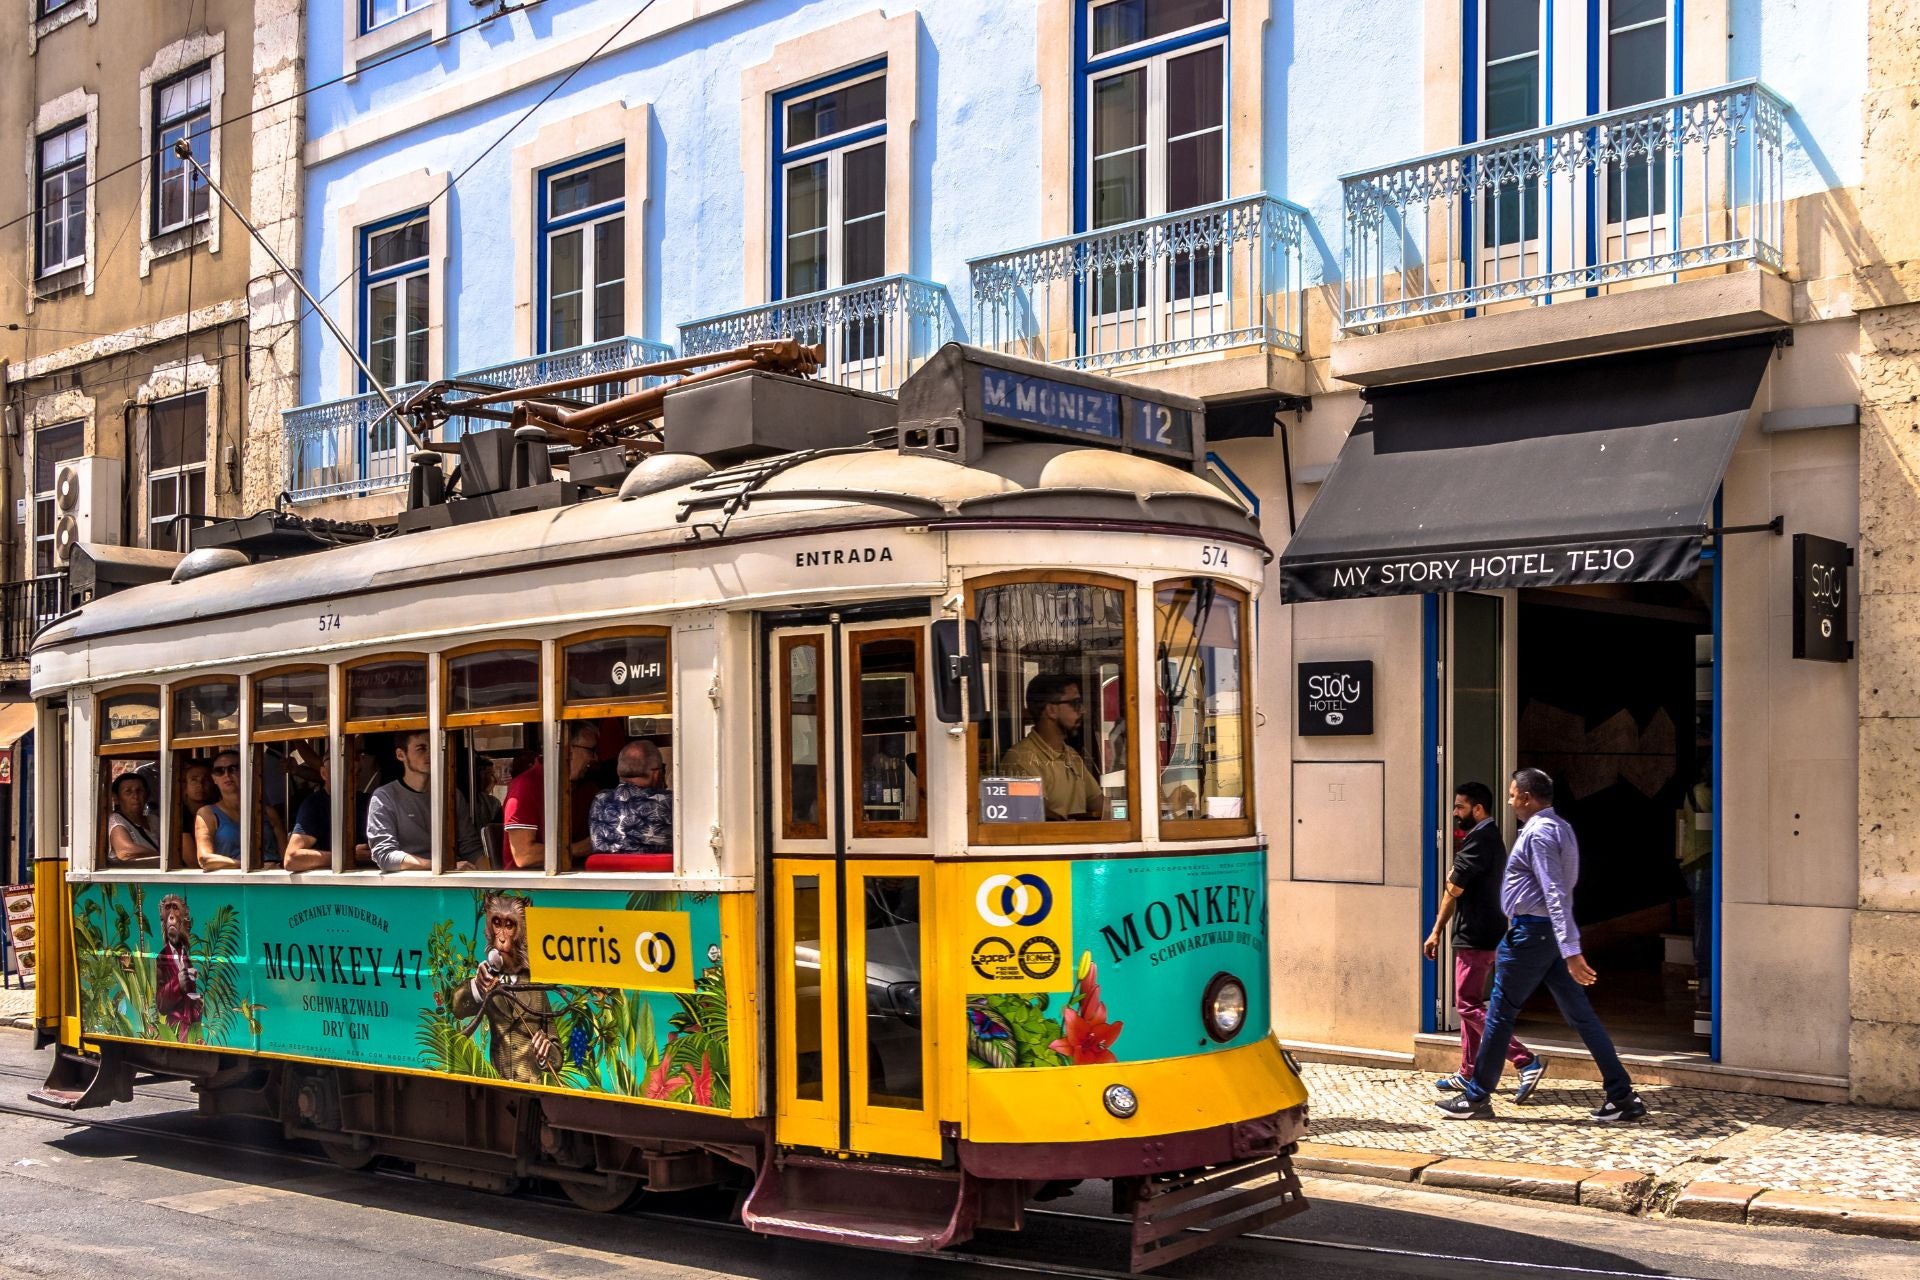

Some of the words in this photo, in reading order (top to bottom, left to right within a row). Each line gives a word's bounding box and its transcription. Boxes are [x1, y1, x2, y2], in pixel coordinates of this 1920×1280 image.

[983, 376, 1011, 409] M.
[1016, 383, 1103, 423] MONIZ
[1142, 405, 1172, 445] 12
[795, 547, 893, 567] ENTRADA
[1202, 545, 1228, 567] 574
[1333, 566, 1370, 587] MY
[1381, 559, 1460, 584] STORY
[1469, 553, 1554, 578] HOTEL
[1567, 548, 1635, 571] TEJO
[319, 613, 340, 631] 574
[630, 662, 661, 679] WI-FI
[1308, 674, 1360, 703] Story
[1309, 700, 1348, 711] HOTEL
[986, 786, 1007, 796] 12E
[986, 805, 1008, 819] 02
[288, 904, 332, 929] CERTAINLY
[334, 904, 389, 933] WUNDERBAR
[1098, 885, 1256, 964] MONKEY
[542, 925, 621, 965] carris
[1150, 930, 1234, 967] SCHWARZWALD
[1236, 931, 1252, 946] DRY
[263, 942, 383, 987] MONKEY
[391, 948, 423, 991] 47
[302, 994, 389, 1018] SCHWARZWALD
[323, 1020, 345, 1038] DRY
[349, 1023, 370, 1041] GIN
